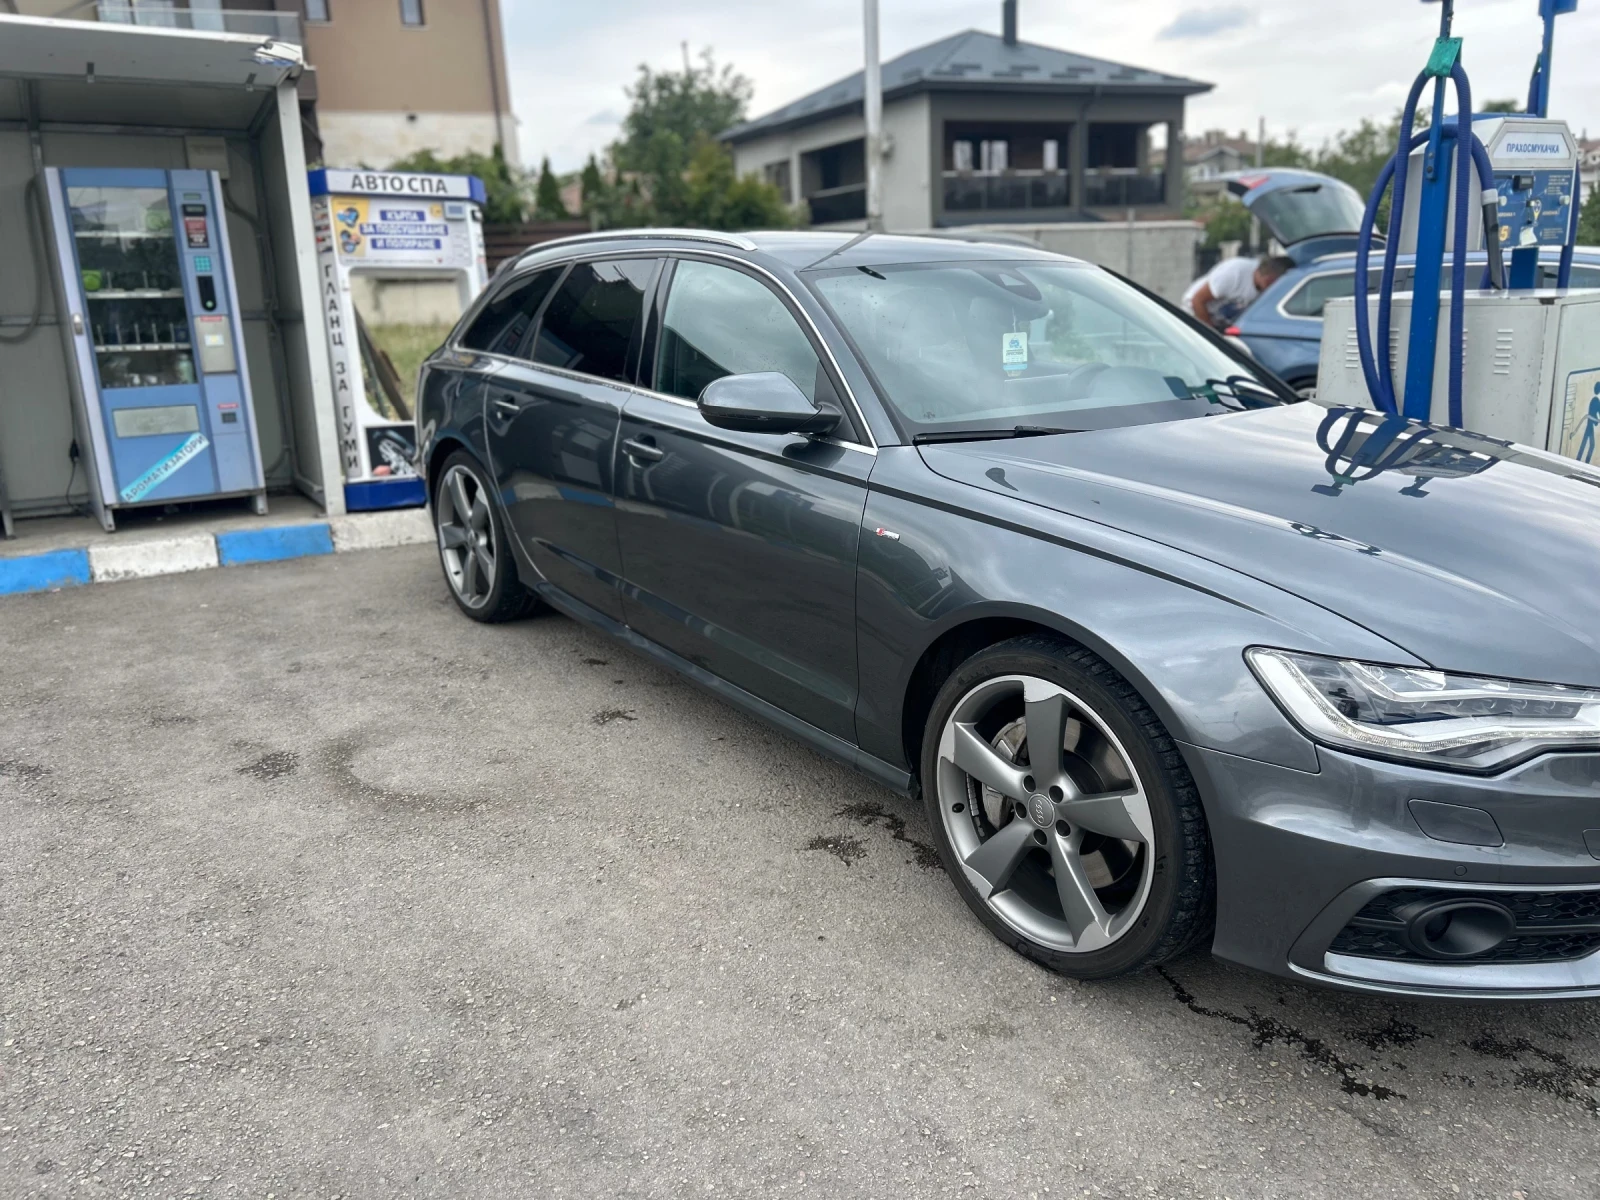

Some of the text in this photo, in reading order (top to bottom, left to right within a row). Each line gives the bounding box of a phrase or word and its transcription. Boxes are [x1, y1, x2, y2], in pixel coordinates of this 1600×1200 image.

[1506, 143, 1560, 153] ПРАХОСМУКАЧКА
[351, 174, 448, 194] АВТОСПА
[386, 211, 419, 221] КЪРПА
[363, 224, 375, 234] ЗА
[376, 238, 434, 249] И ПОЛИРАНЕ
[324, 264, 358, 468] ГЛАНЦ ЗА ГУМИ
[125, 435, 205, 501] АРОМАТИЗАТОРИ
